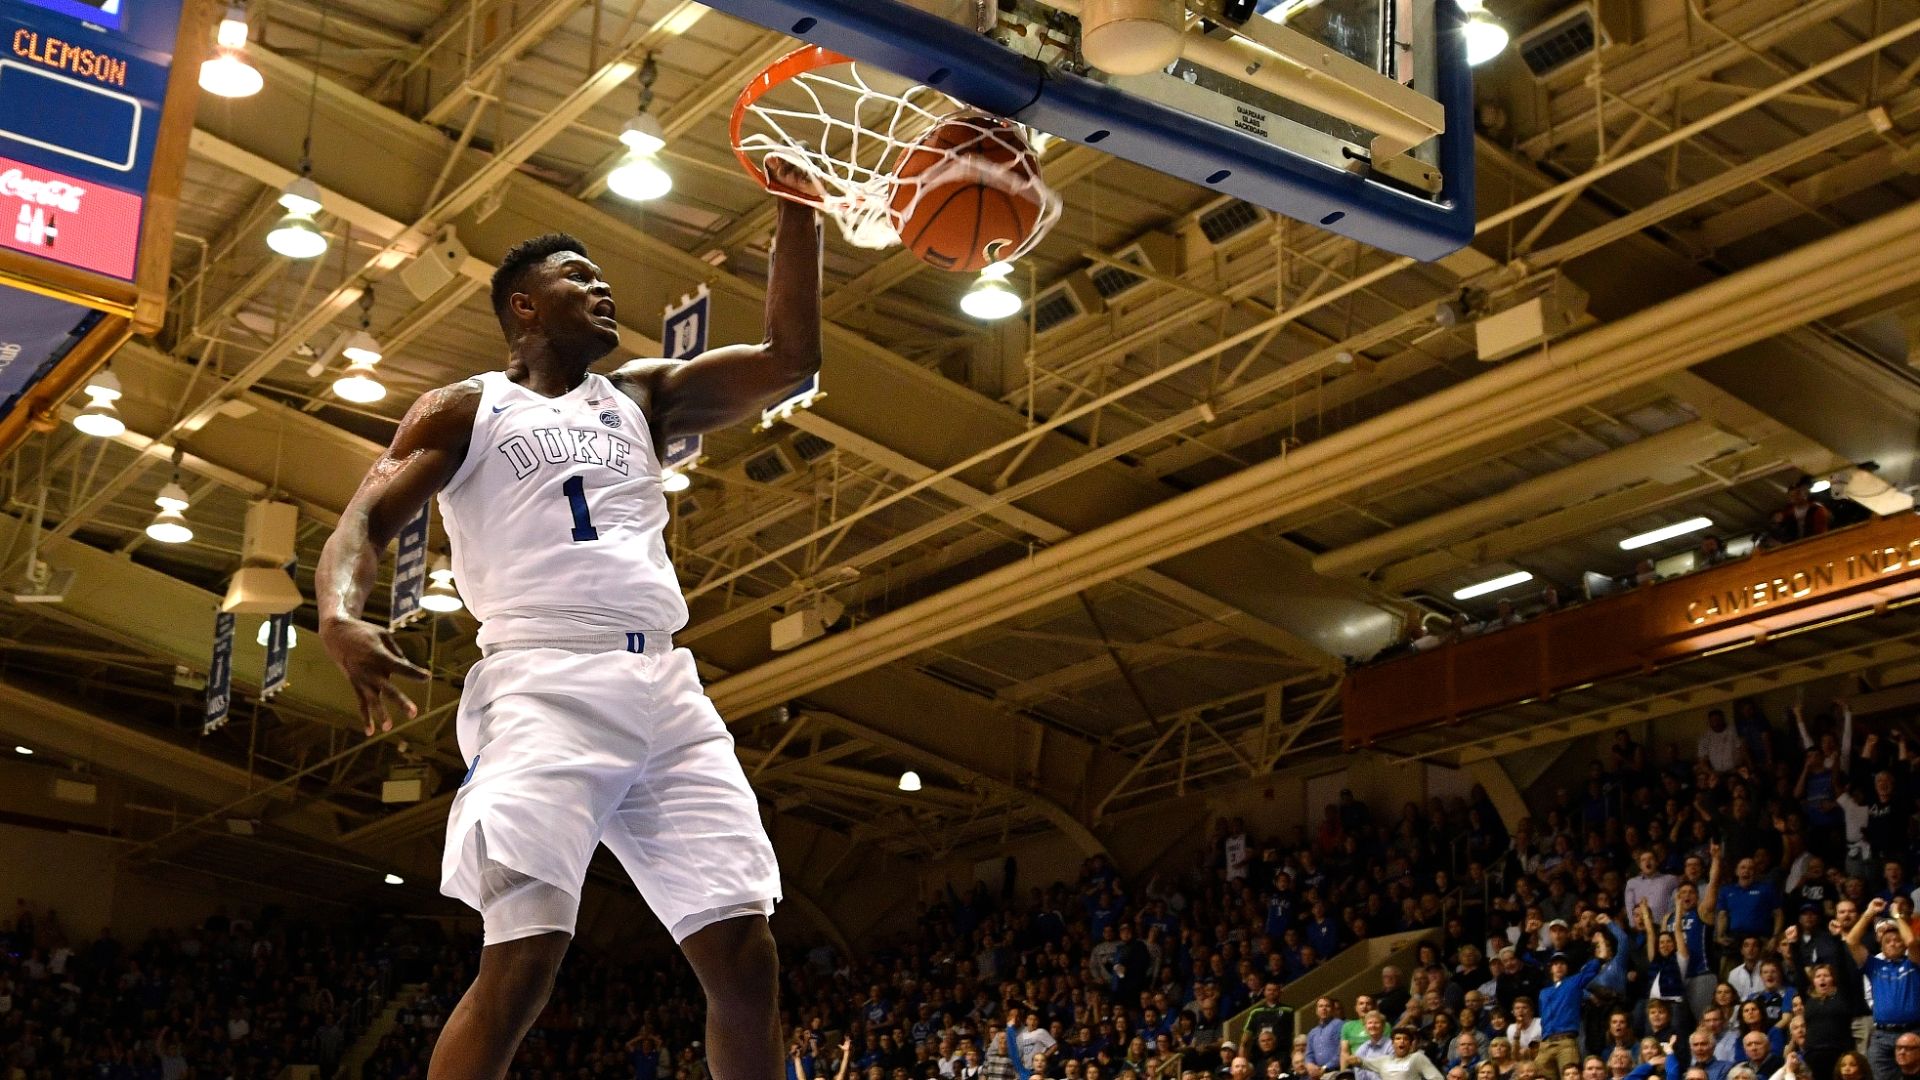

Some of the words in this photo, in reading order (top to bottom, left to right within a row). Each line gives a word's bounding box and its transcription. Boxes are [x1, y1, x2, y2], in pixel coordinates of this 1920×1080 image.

[13, 28, 127, 86] CLEMSON
[1235, 120, 1267, 137] BACKBOARD
[1237, 106, 1265, 121] GUARDIAN
[498, 427, 631, 481] DUKE
[563, 475, 599, 542] 1
[1686, 562, 1834, 624] CAMERON
[625, 632, 646, 654] D
